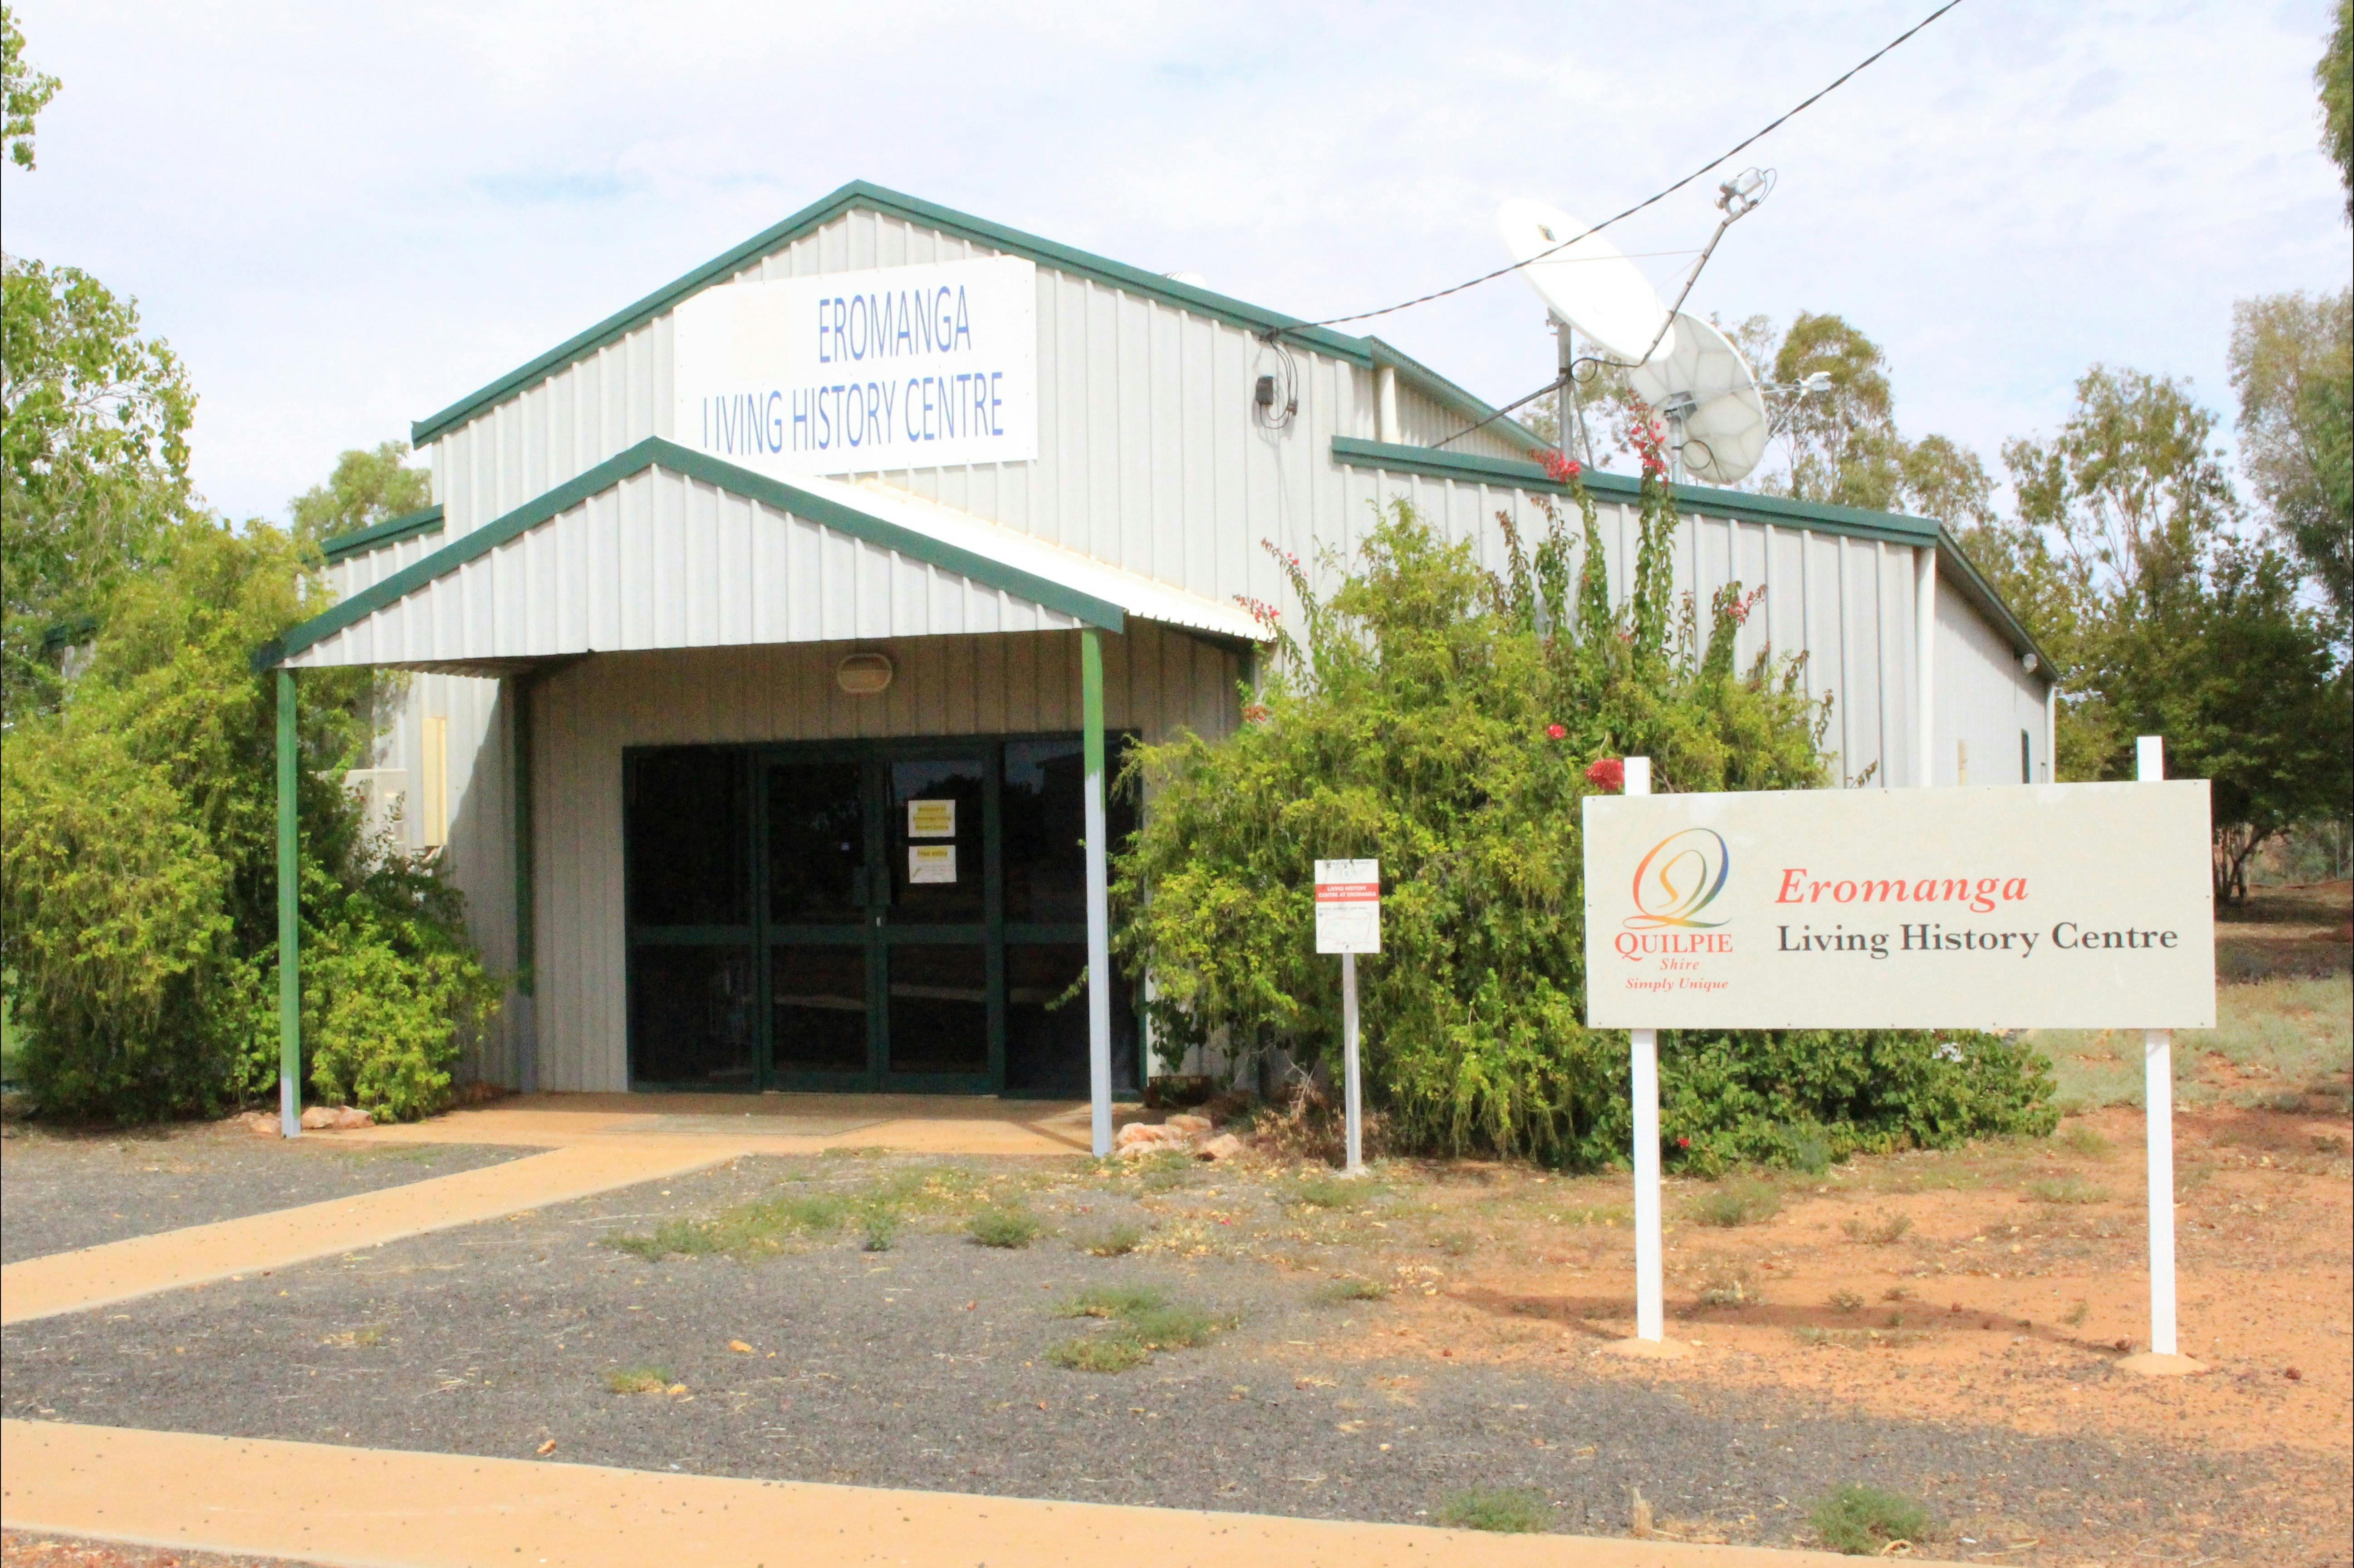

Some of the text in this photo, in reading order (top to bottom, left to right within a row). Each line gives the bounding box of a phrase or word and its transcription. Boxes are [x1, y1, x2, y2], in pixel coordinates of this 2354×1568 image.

[819, 285, 971, 363] EROMANGA
[793, 380, 897, 452] HISTORY
[906, 372, 1004, 442] CENTRE
[1775, 867, 2029, 914] Eromanga
[1614, 932, 1734, 962] QUILPIE
[1777, 921, 2179, 960] Living History Centre
[1660, 958, 1700, 970] Shire
[1626, 978, 1729, 993] Simply Unique
